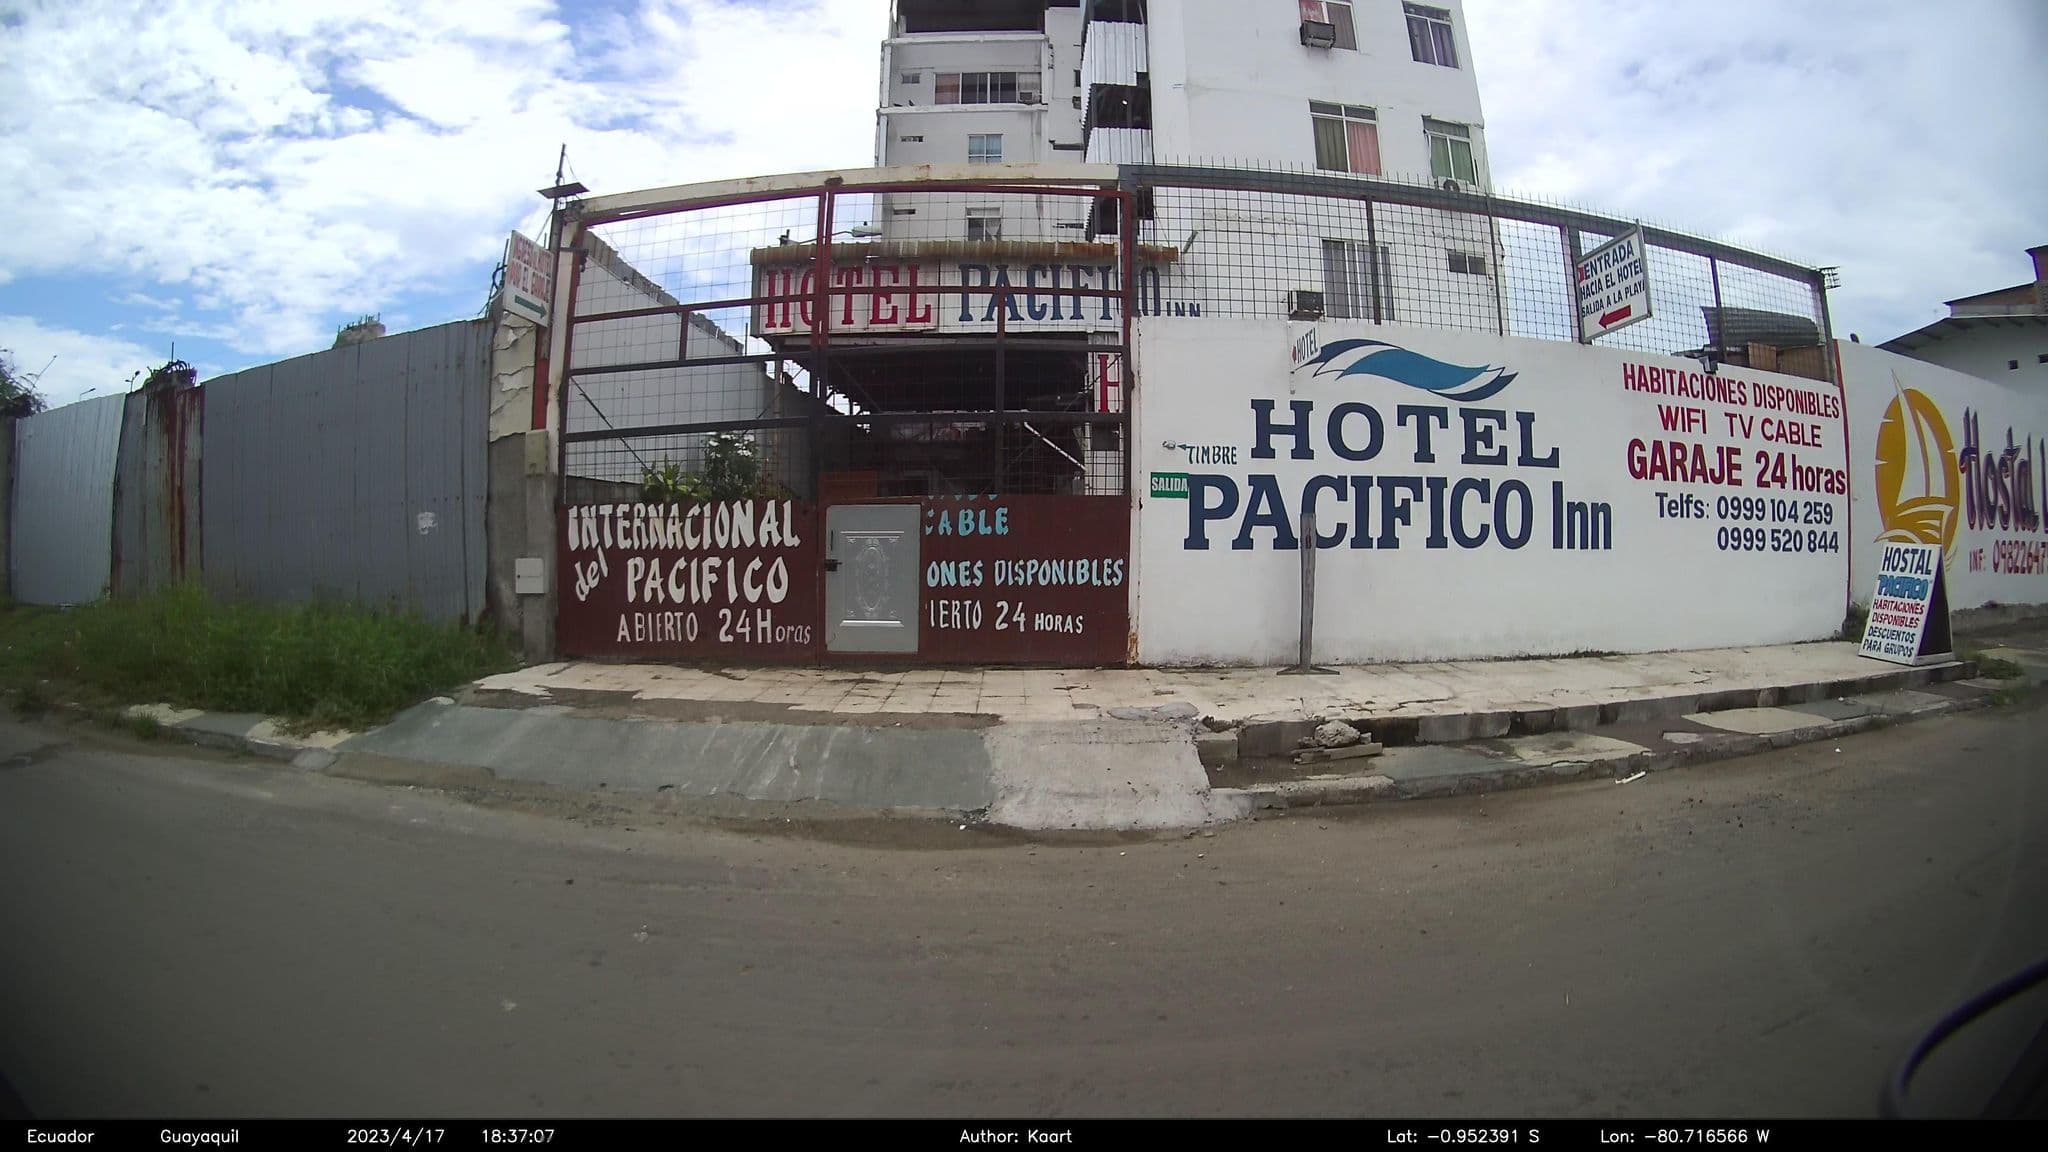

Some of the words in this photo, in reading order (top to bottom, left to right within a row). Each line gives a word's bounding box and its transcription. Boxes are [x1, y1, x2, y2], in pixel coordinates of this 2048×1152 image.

[1584, 240, 1635, 280] ENTRADA
[958, 264, 1160, 322] PACIFIO
[1166, 301, 1201, 317] INN
[1580, 278, 1603, 301] HACIA
[1605, 273, 1616, 289] EL
[1617, 258, 1643, 281] HOTEL
[1581, 299, 1605, 317] SALIDA
[1606, 295, 1612, 308] A
[1613, 289, 1624, 305] LA
[1296, 327, 1319, 363] HOTEL
[1622, 362, 1747, 406] HABITACIONES
[1752, 382, 1840, 419] DISPONIBLES
[1250, 399, 1560, 468] HOTEL
[1657, 404, 1708, 434] WIFI
[1724, 412, 1754, 439] TV
[1760, 418, 1823, 448] CABLE
[1187, 446, 1238, 465] TIMBRE
[1627, 438, 1743, 487] GARAJE
[1755, 450, 1788, 490] 24
[1791, 453, 1847, 496] horas
[1959, 406, 2040, 533] Hostal
[1151, 476, 1189, 491] SALIDA
[568, 500, 800, 551] INTERNACIONAL
[1184, 474, 1534, 551] PACIFICO
[1552, 481, 1613, 551] Inn
[1655, 491, 1711, 519] Telfs:
[1716, 495, 1766, 522] 0999
[1770, 498, 1799, 523] 104
[1803, 501, 1833, 525] 259
[1717, 526, 1767, 551] 0999
[1770, 528, 1804, 553] 520
[1807, 530, 1839, 553] 844
[1993, 539, 2048, 575] 09822647
[574, 546, 608, 602] del
[627, 556, 789, 604] PACIFICO
[994, 558, 1124, 588] DISPONIBLES
[1882, 546, 1932, 575] HOSTAL
[995, 600, 1026, 632] 24
[1035, 612, 1084, 634] HORAS
[1872, 612, 1920, 628] DISPONIBLES
[1873, 598, 1925, 615] HABITACIONES
[617, 611, 699, 642] ABIERTO
[1868, 626, 1916, 644] DESCUENTOS
[1862, 639, 1882, 653] PARA
[1884, 643, 1914, 658] GRUPOS
